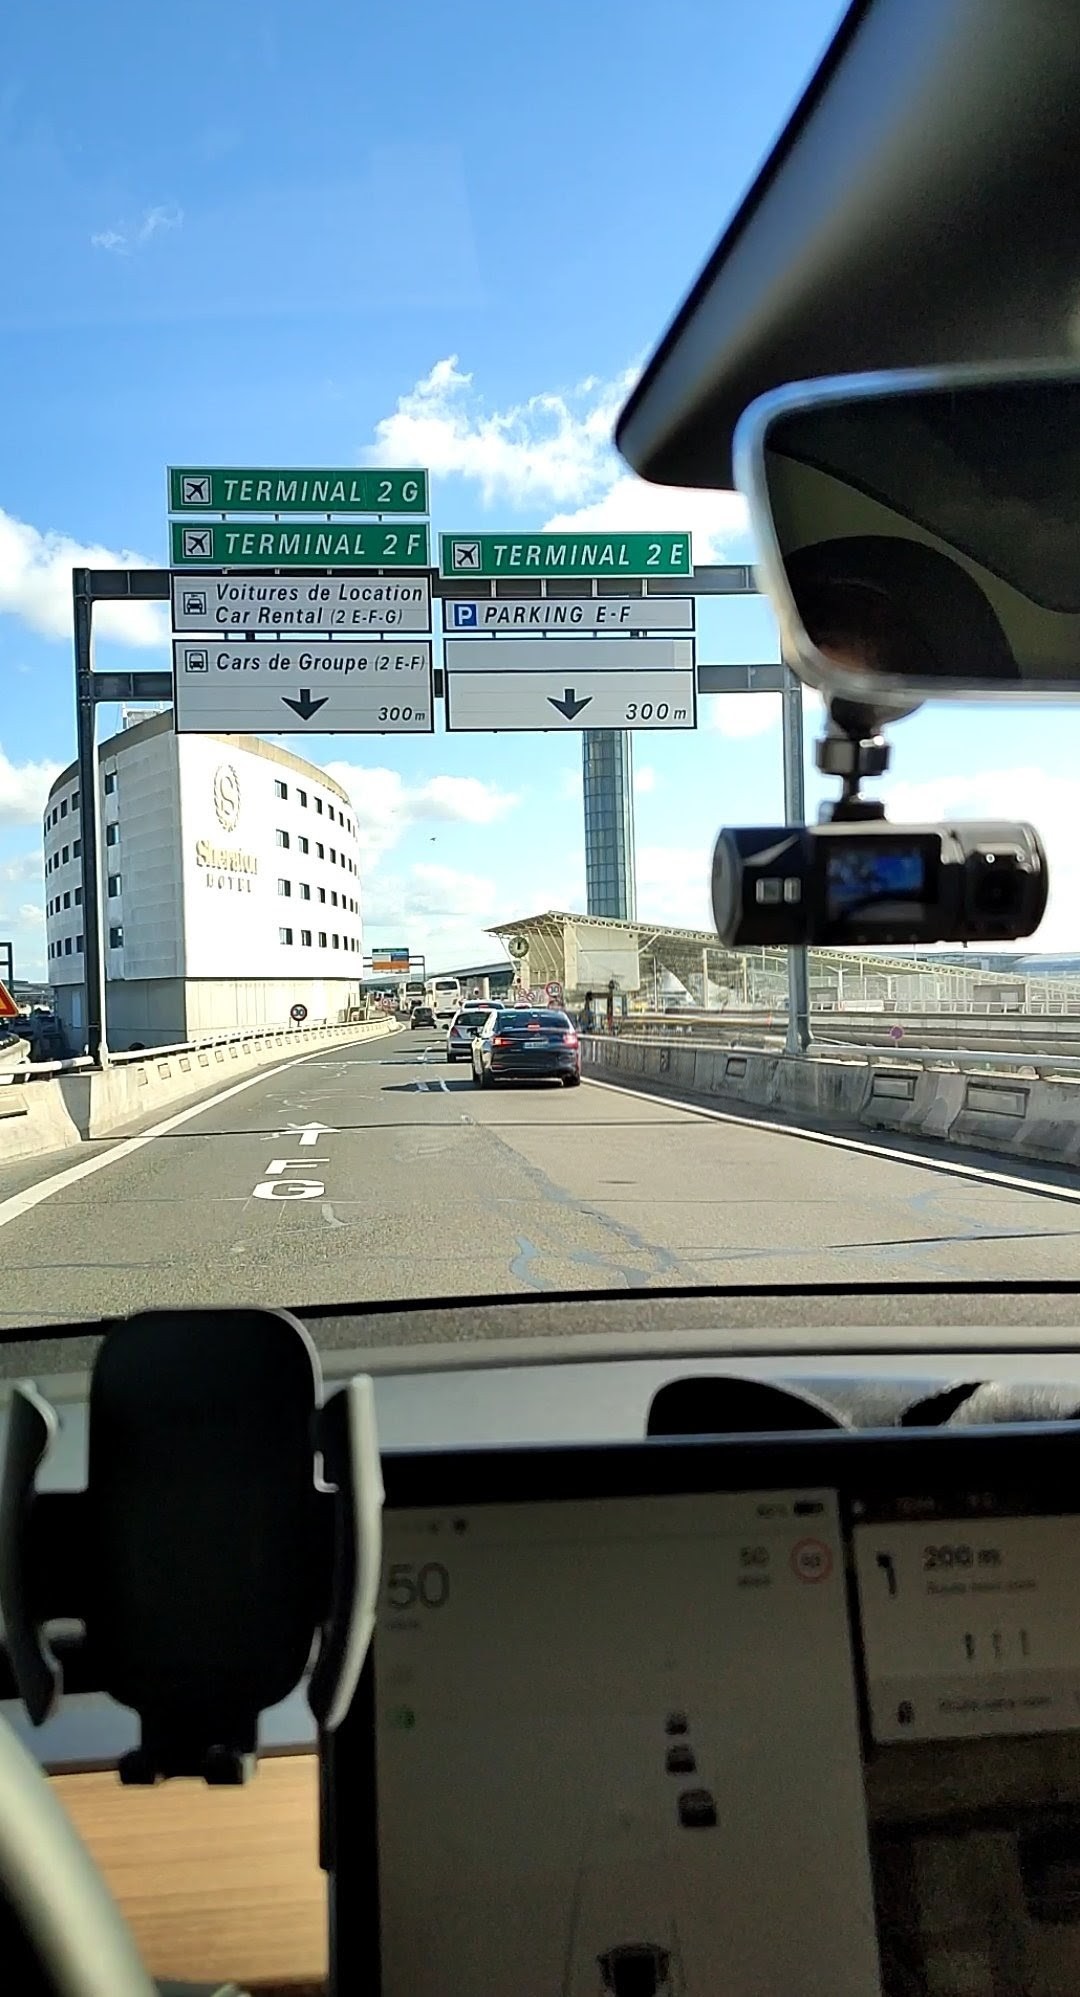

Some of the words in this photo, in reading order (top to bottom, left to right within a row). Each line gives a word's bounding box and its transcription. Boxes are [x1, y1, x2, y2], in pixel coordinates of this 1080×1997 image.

[223, 479, 361, 503] TERMINAL
[225, 532, 366, 556] TERMINAL
[493, 543, 630, 567] TERMINAL
[216, 582, 299, 601] Voitures
[307, 583, 329, 601] de
[338, 583, 423, 602] Location
[215, 606, 250, 625] Car
[257, 606, 323, 625] Rental
[329, 608, 346, 625] (2
[351, 608, 403, 625] E-F-G)
[484, 605, 584, 625] PARKING
[595, 605, 632, 624] E-F
[216, 652, 261, 671] Cars
[268, 652, 292, 671] de
[299, 652, 369, 675] Groupe
[374, 655, 389, 672] (2
[394, 655, 426, 672] E-F)
[377, 706, 413, 722] 300
[414, 711, 426, 722] m
[625, 702, 669, 721] 300
[673, 708, 687, 721] m
[252, 1178, 326, 1201] G
[386, 1562, 452, 1610] 50
